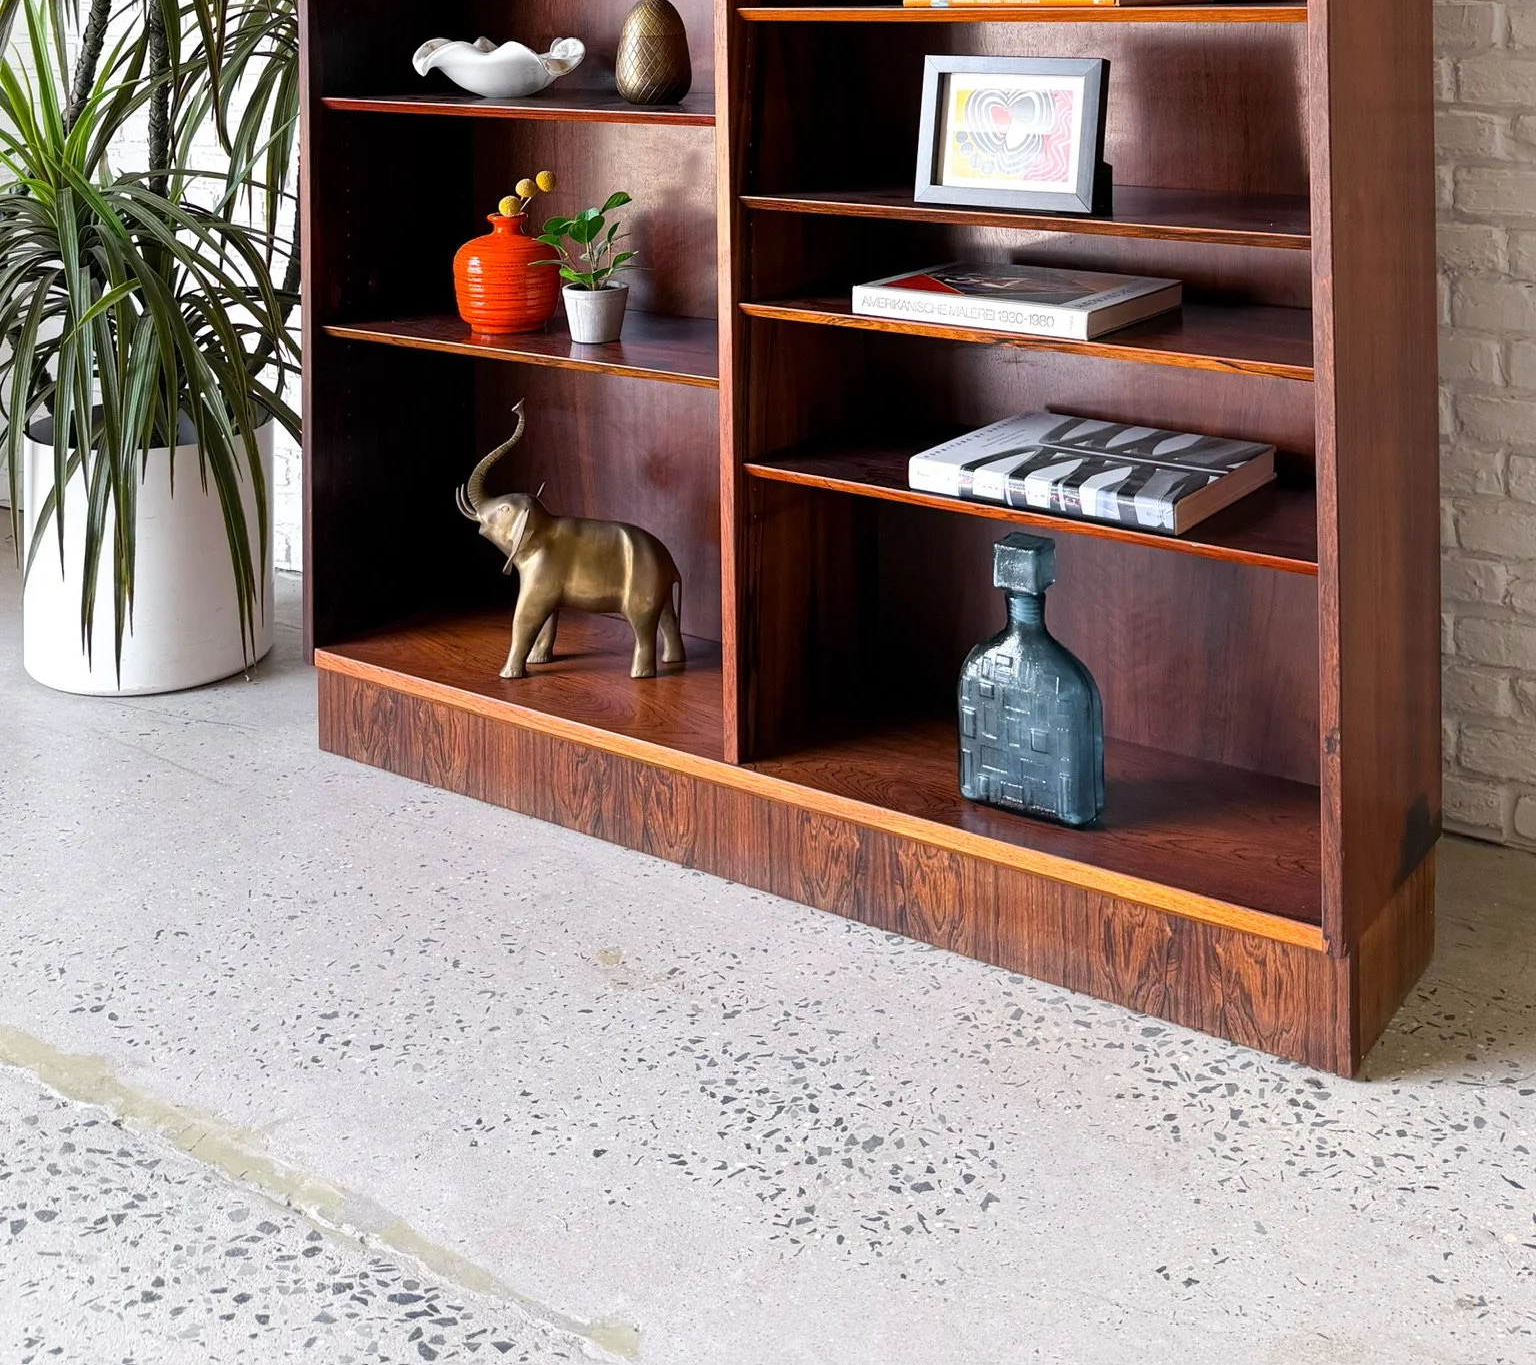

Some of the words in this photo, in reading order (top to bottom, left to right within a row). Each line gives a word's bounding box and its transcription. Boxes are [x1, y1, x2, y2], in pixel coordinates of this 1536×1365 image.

[861, 295, 947, 316] AMERIKANISCHE
[948, 305, 996, 322] MALEREI
[998, 310, 1055, 328] 1930-1980
